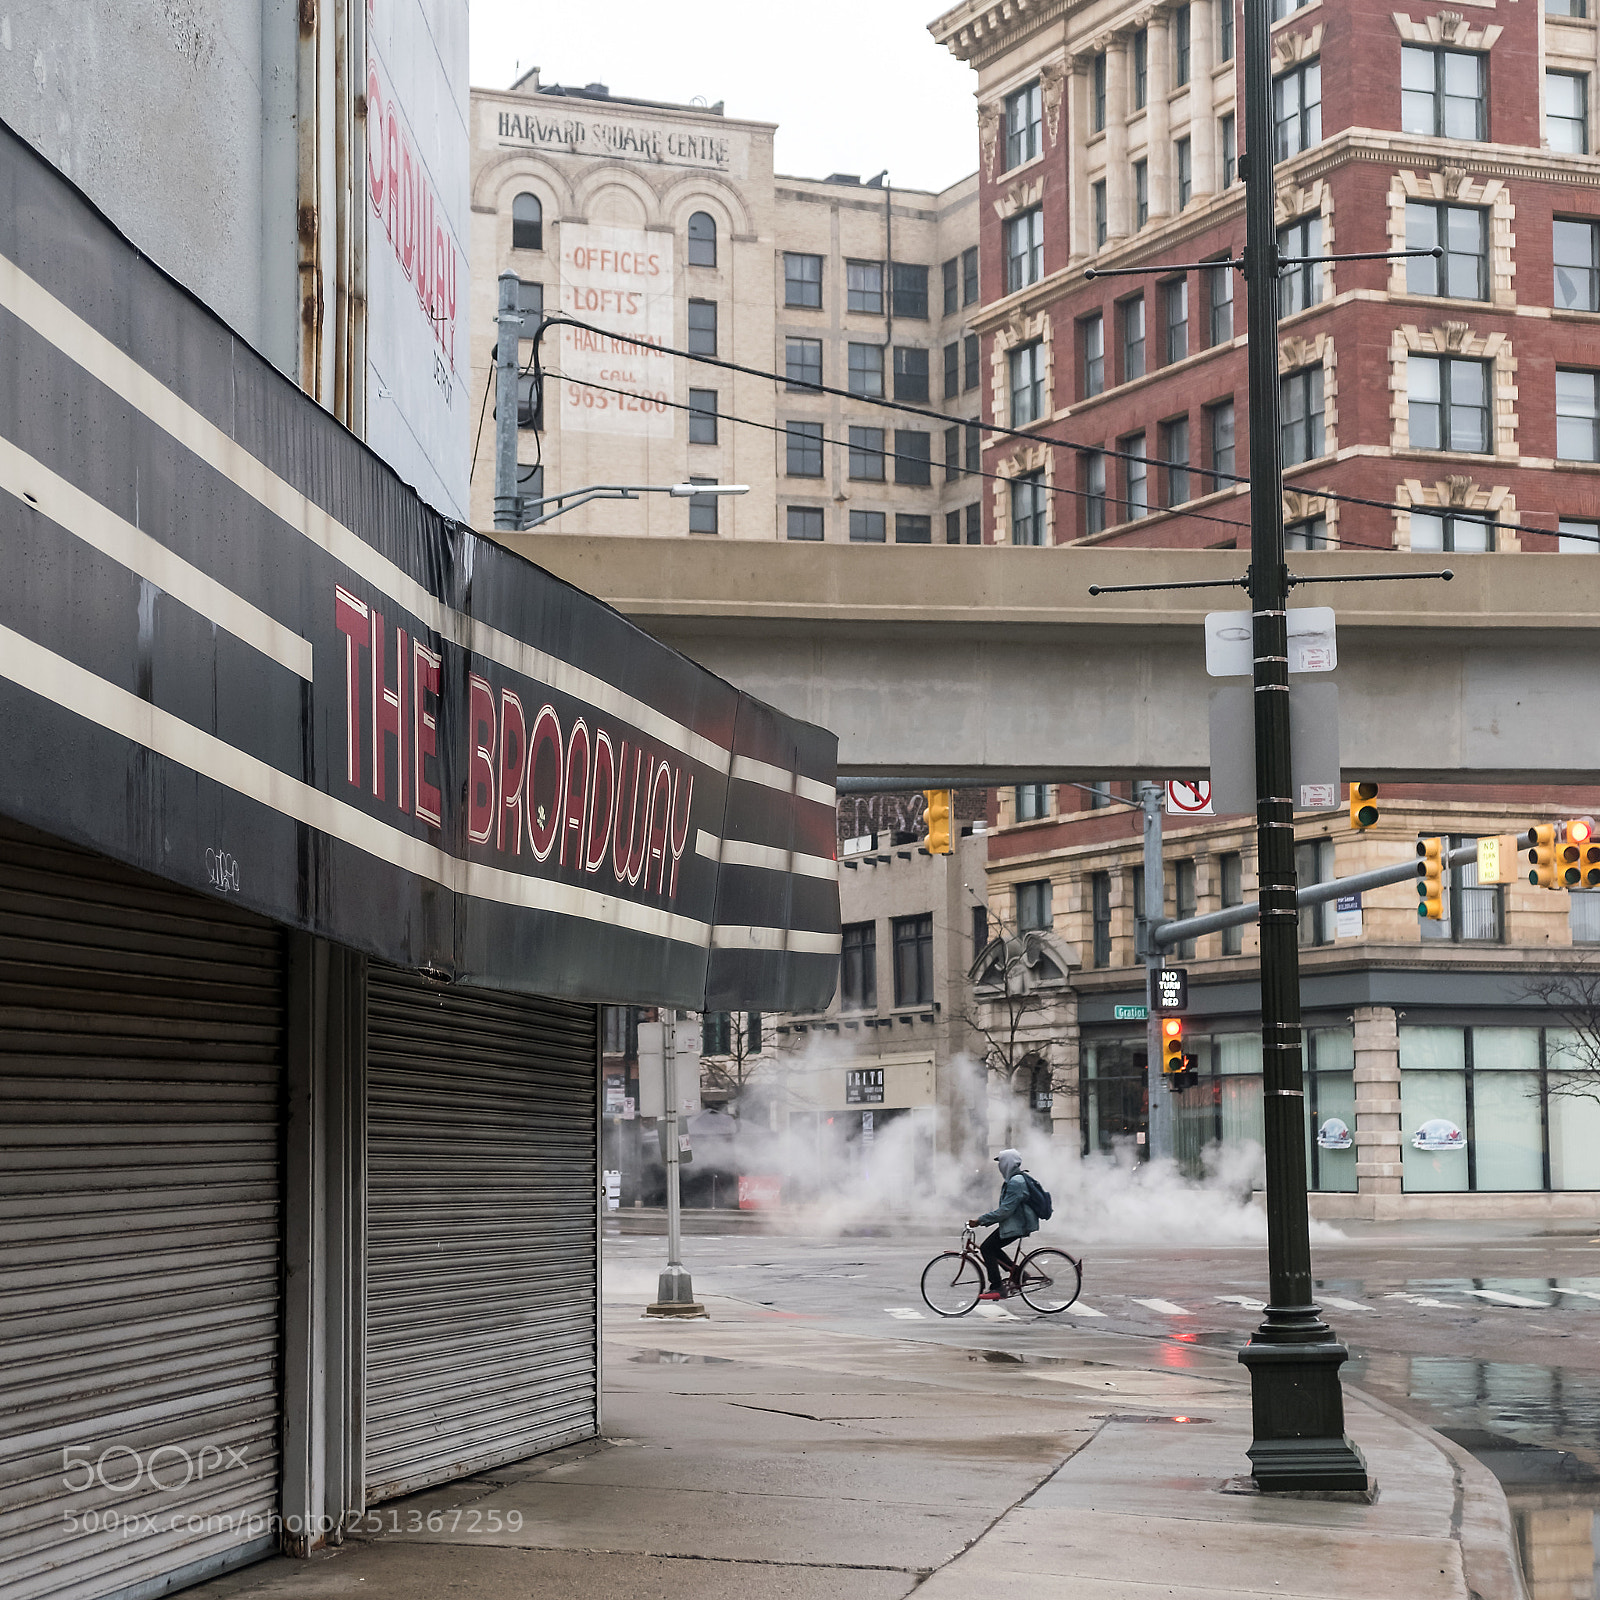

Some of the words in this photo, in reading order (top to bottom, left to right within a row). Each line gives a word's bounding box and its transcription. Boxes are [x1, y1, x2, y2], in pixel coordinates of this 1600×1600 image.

[498, 110, 586, 144] HARVARD
[592, 122, 662, 159] SQUARE
[668, 132, 730, 165] CENTRE
[574, 246, 660, 276] OFFICES
[573, 286, 638, 315] LOFTS
[574, 328, 607, 353] HALL
[611, 332, 665, 358] RENTAL
[600, 369, 637, 383] CALL
[335, 583, 442, 829] THE
[468, 670, 695, 900] BROADWAY
[1483, 841, 1495, 850] NO
[1161, 971, 1178, 981] NO
[1158, 981, 1181, 990] TURN
[1163, 990, 1176, 998] ON
[1162, 998, 1179, 1007] RED
[1119, 1007, 1145, 1017] Gratiot
